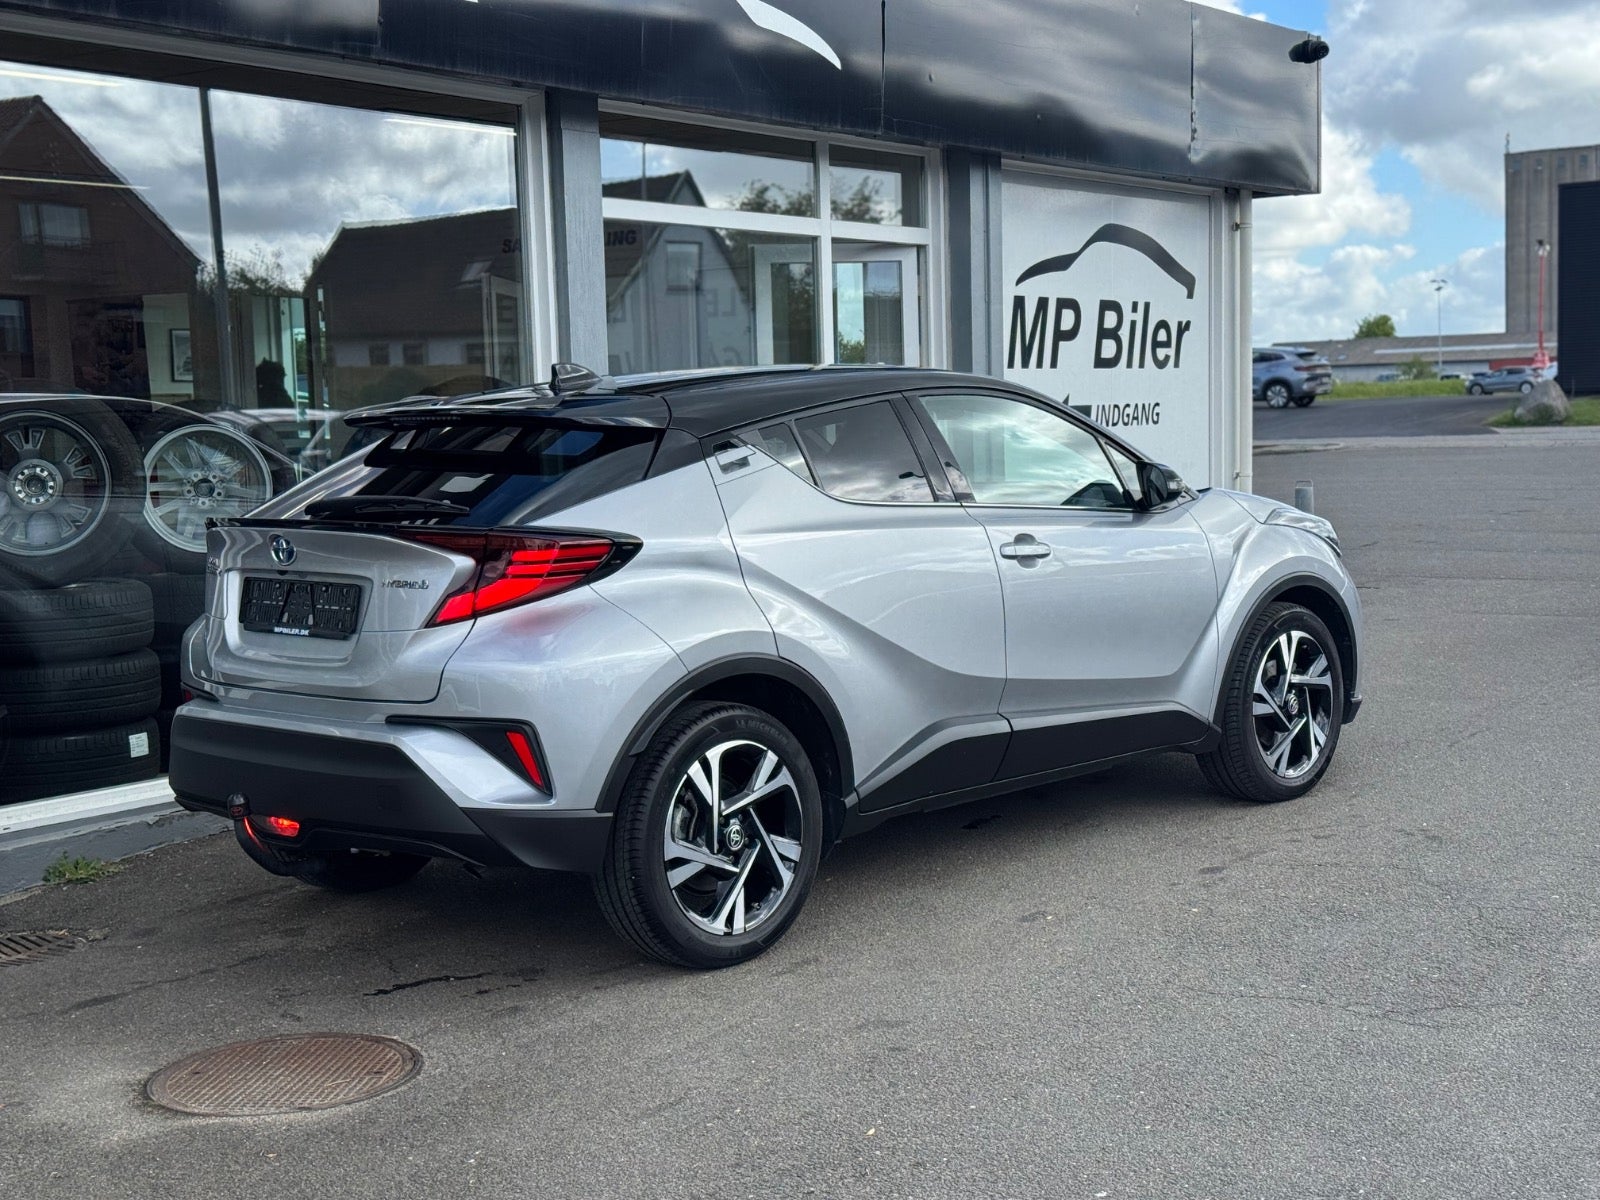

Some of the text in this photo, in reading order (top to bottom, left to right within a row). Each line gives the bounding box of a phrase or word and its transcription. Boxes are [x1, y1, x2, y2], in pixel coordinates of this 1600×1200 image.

[1007, 295, 1191, 370] MP Biler
[1096, 402, 1160, 427] INDGANG
